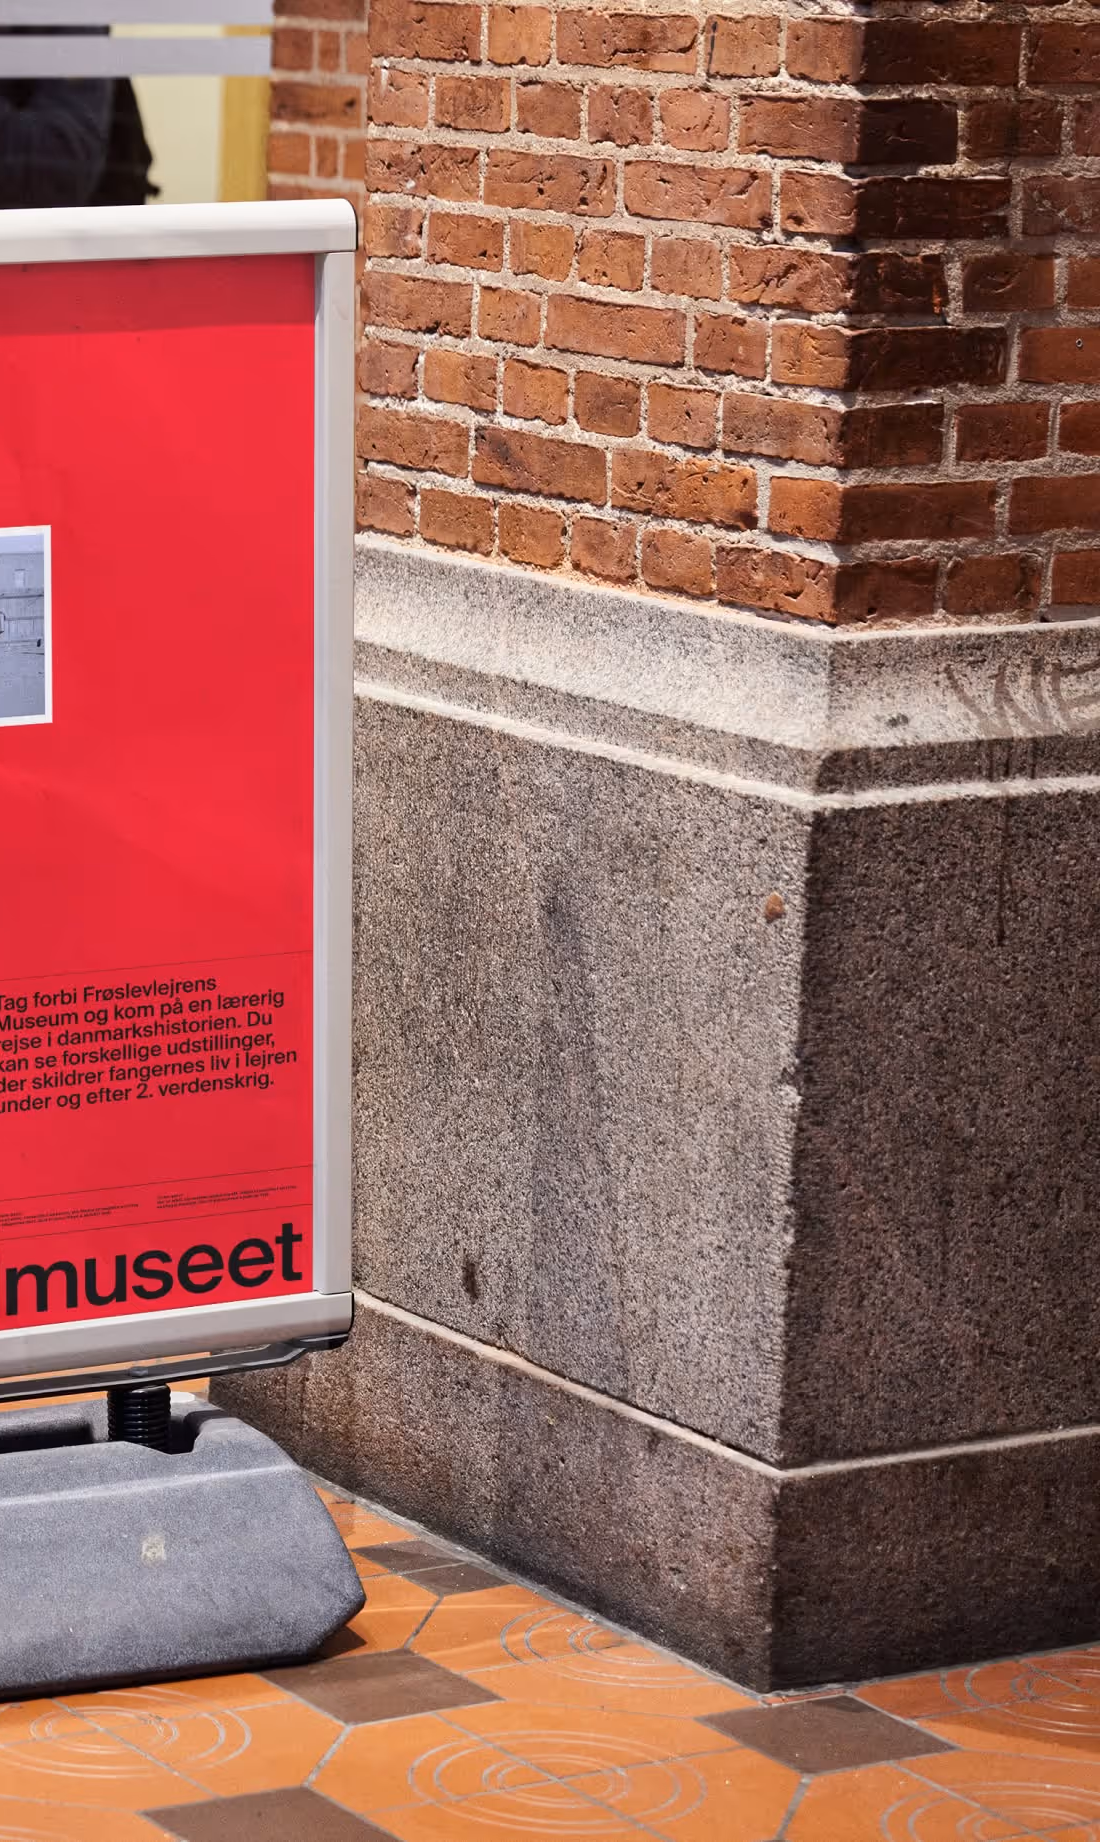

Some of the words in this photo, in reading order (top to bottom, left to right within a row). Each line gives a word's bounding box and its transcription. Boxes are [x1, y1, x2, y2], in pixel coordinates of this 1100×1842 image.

[32, 987, 78, 1008] forbi
[83, 977, 217, 1003] Frøslevlejrens
[83, 1008, 109, 1026] og
[113, 1003, 155, 1021] kom
[160, 996, 184, 1019] på
[188, 998, 213, 1013] en
[217, 988, 285, 1010] lærerig
[46, 1030, 52, 1048] i
[56, 1016, 242, 1047] danmarkshistorien.
[247, 1011, 273, 1027] Du
[31, 1069, 104, 1090] skildrer
[108, 1060, 205, 1083] fangernes
[210, 1054, 231, 1071] liv
[234, 1051, 240, 1069] i
[245, 1050, 297, 1070] lejren
[34, 1055, 58, 1070] se
[62, 1043, 162, 1067] forskellige
[167, 1032, 275, 1056] udstillinger,
[56, 1093, 81, 1110] og
[85, 1086, 132, 1105] efter
[136, 1082, 154, 1100] 2.
[158, 1072, 274, 1098] verdenskrig.
